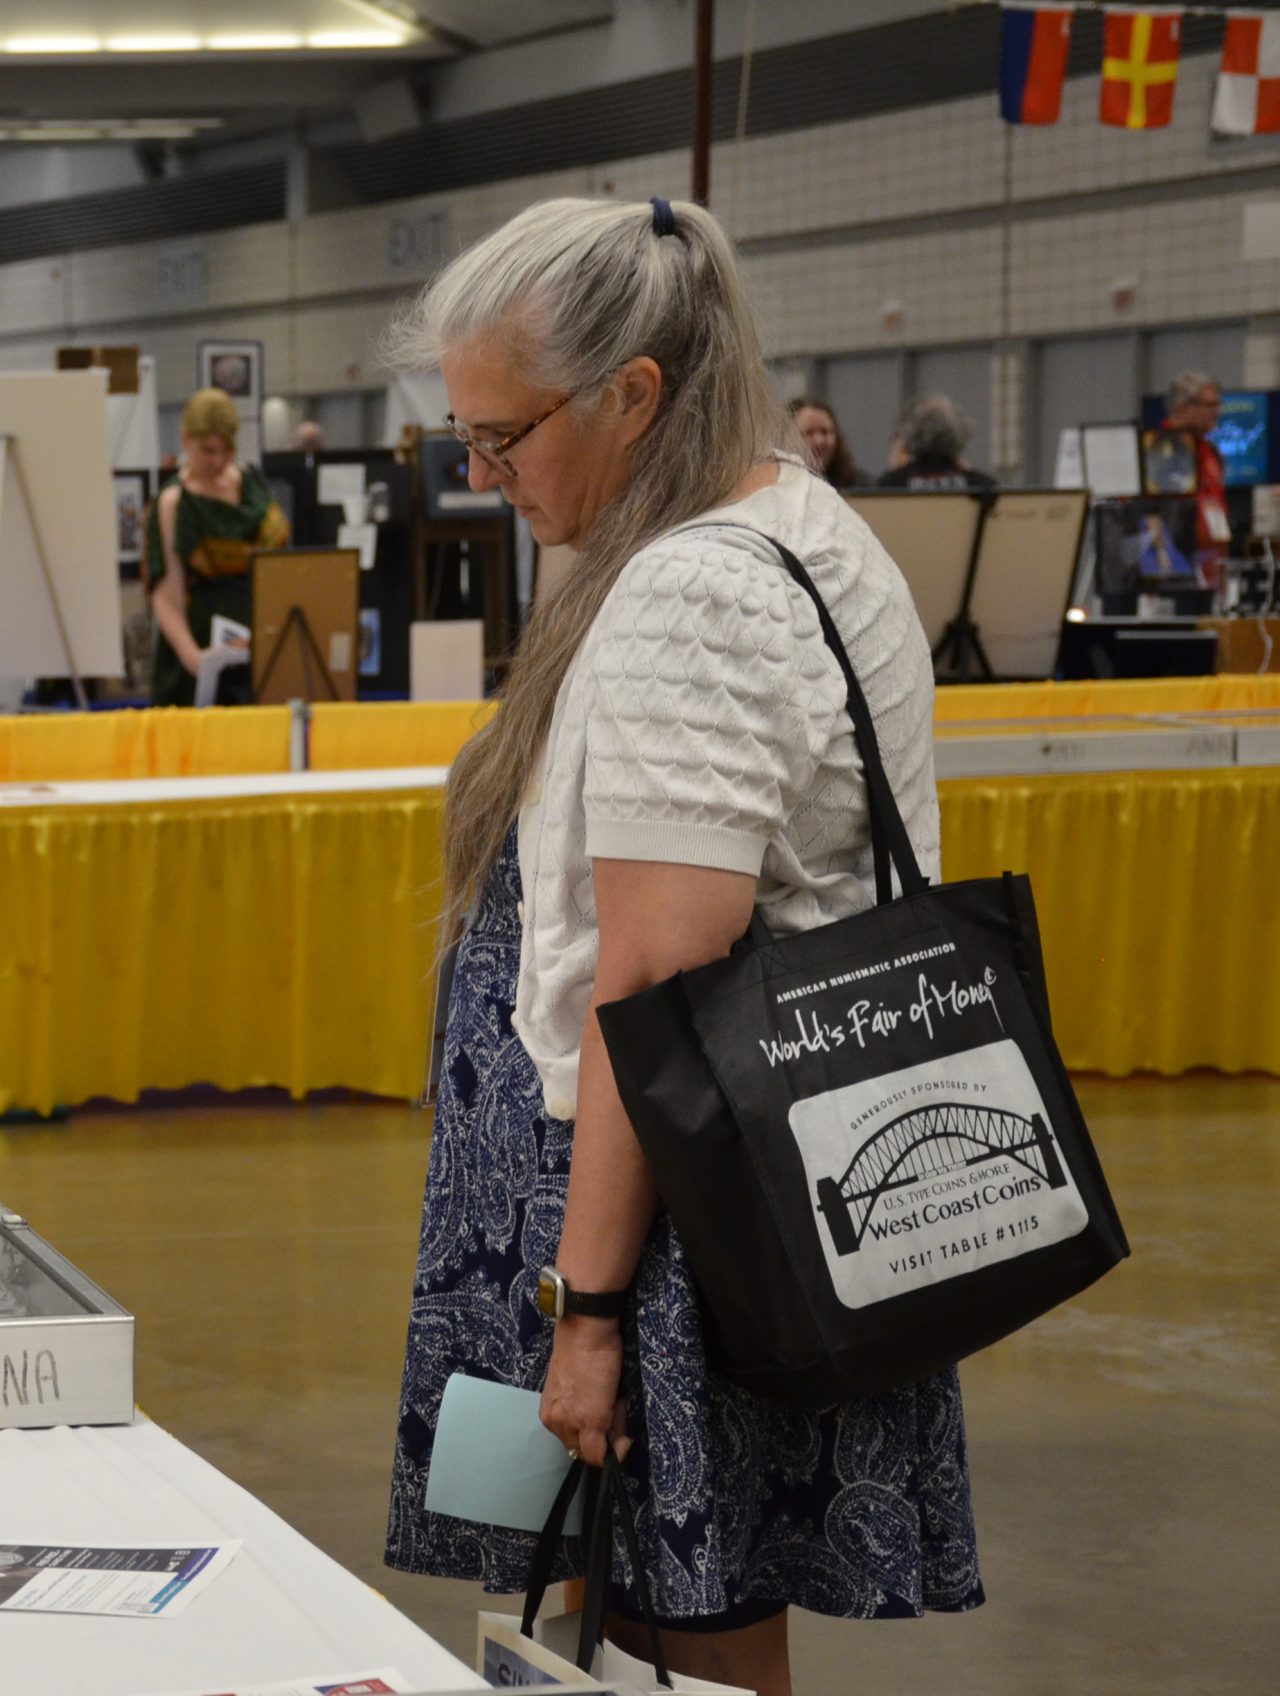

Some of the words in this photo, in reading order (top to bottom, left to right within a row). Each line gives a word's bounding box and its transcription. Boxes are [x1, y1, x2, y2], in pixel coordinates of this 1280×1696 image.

[776, 980, 827, 1004] AMERICAN
[830, 962, 891, 987] NUMISMATIC
[893, 942, 956, 968] ASSOCIATION
[759, 1008, 845, 1067] World's
[848, 1000, 902, 1048] Fair
[909, 973, 932, 1039] of
[851, 1090, 907, 1130] GENEROUSLY
[911, 1080, 968, 1095] SPONSORED
[974, 1084, 987, 1092] BY
[868, 1210, 921, 1241] West
[923, 1192, 982, 1224] Coast
[983, 1176, 1041, 1205] Coins
[884, 1196, 907, 1210] U.S.
[908, 1188, 930, 1204] TYPE
[931, 1178, 967, 1195] COINS
[890, 1250, 933, 1274] VISIT
[941, 1232, 988, 1259] TABLE
[996, 1215, 1039, 1240] #1115
